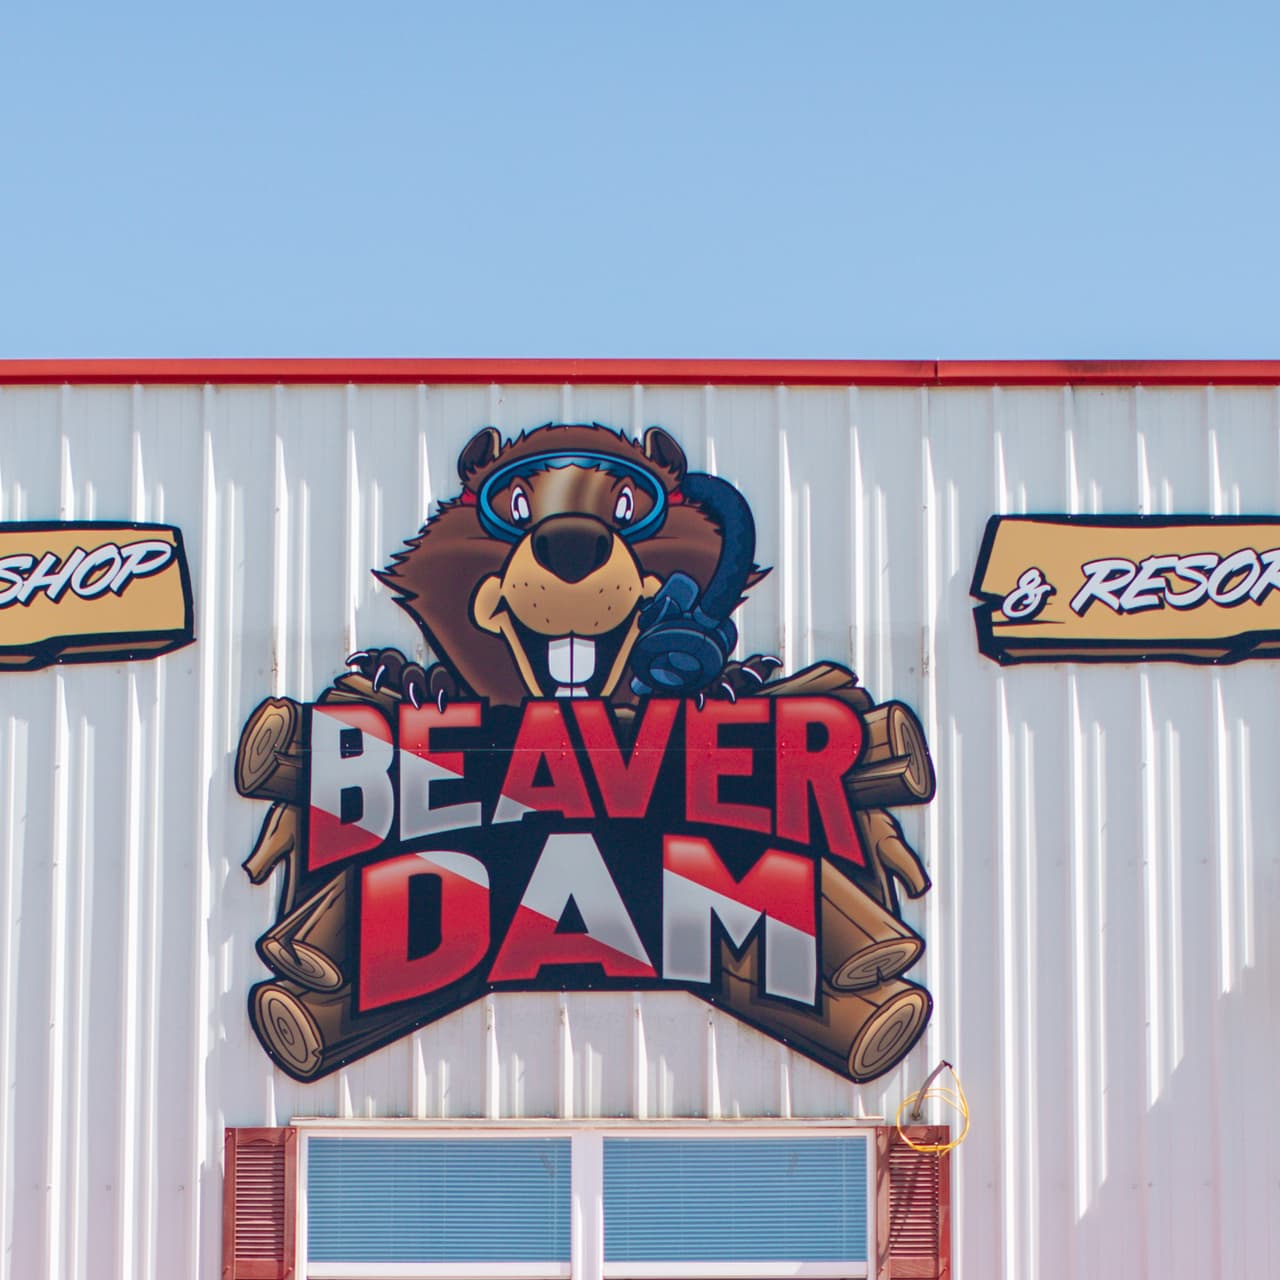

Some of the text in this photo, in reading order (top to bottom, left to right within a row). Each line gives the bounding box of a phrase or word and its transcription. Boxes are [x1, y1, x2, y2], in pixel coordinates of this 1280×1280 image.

[1001, 567, 1051, 619] &
[308, 696, 865, 872] BEAVER
[358, 831, 818, 1011] DAM
